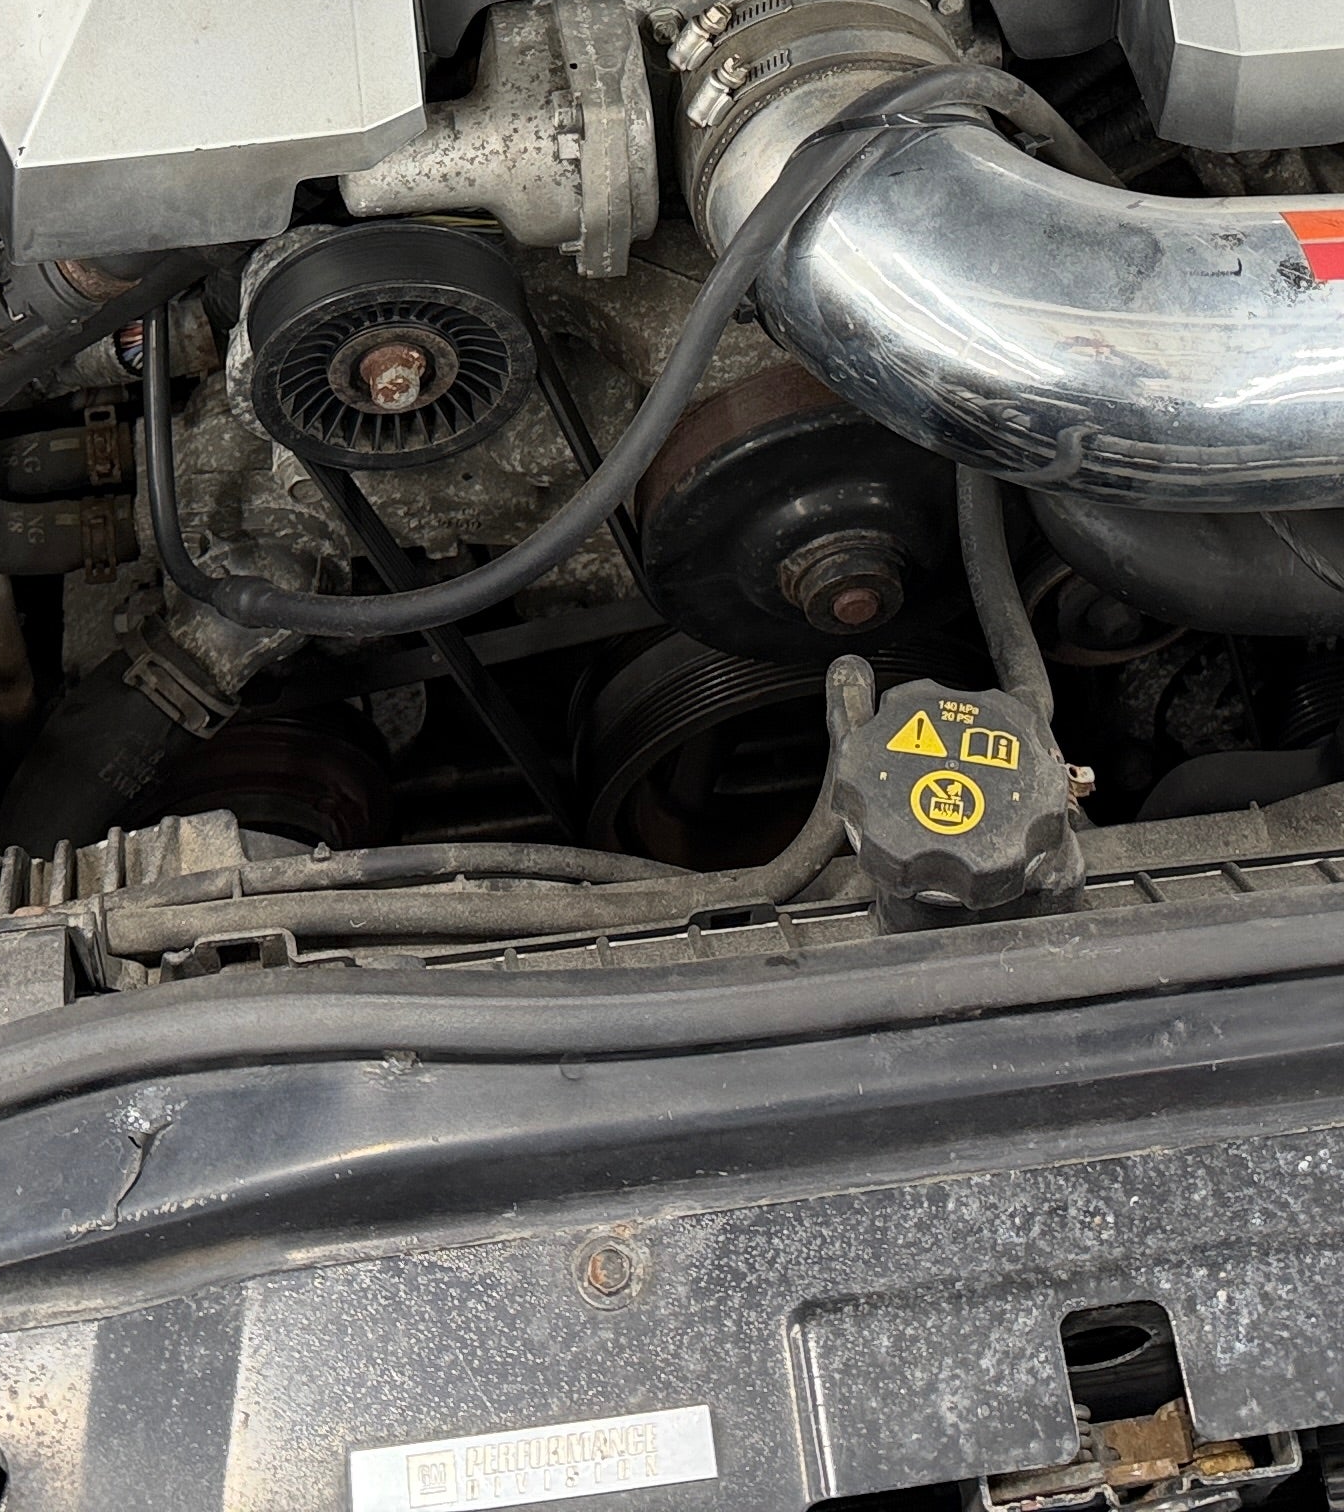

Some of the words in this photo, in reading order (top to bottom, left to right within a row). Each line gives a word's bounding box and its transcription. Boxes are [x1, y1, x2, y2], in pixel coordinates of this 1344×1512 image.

[938, 699, 957, 712] 140
[959, 701, 980, 715] kPa
[941, 711, 955, 722] 20
[956, 712, 974, 724] PSI
[464, 1422, 658, 1477] PERFORMANCE
[417, 1461, 447, 1487] GM
[465, 1459, 659, 1502] DIVISION
